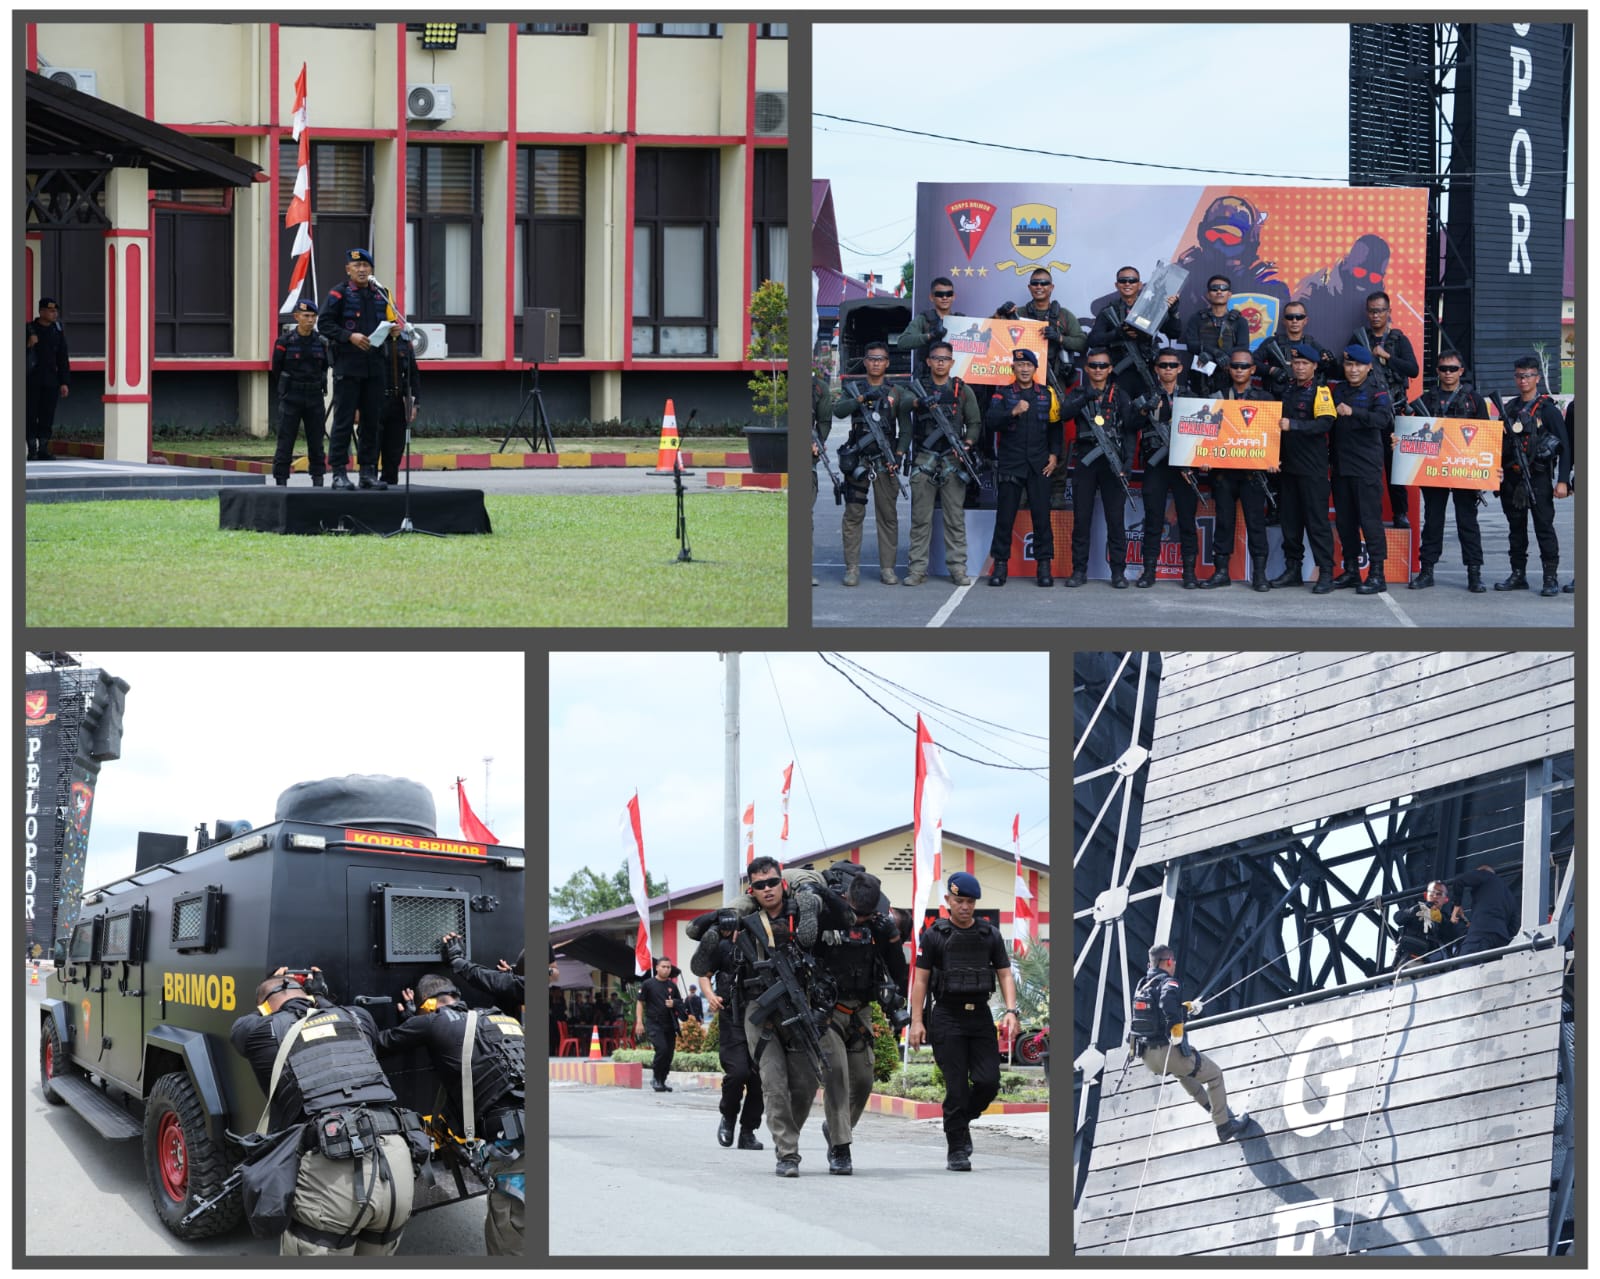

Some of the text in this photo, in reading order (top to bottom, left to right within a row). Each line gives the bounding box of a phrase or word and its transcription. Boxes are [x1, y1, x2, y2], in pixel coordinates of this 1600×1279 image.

[1508, 23, 1533, 274] POR
[1224, 437, 1260, 447] JUARA
[26, 737, 41, 920] PELOPOR
[353, 832, 480, 855] KORPS BRIMOB
[163, 972, 236, 1012] BRIMOB
